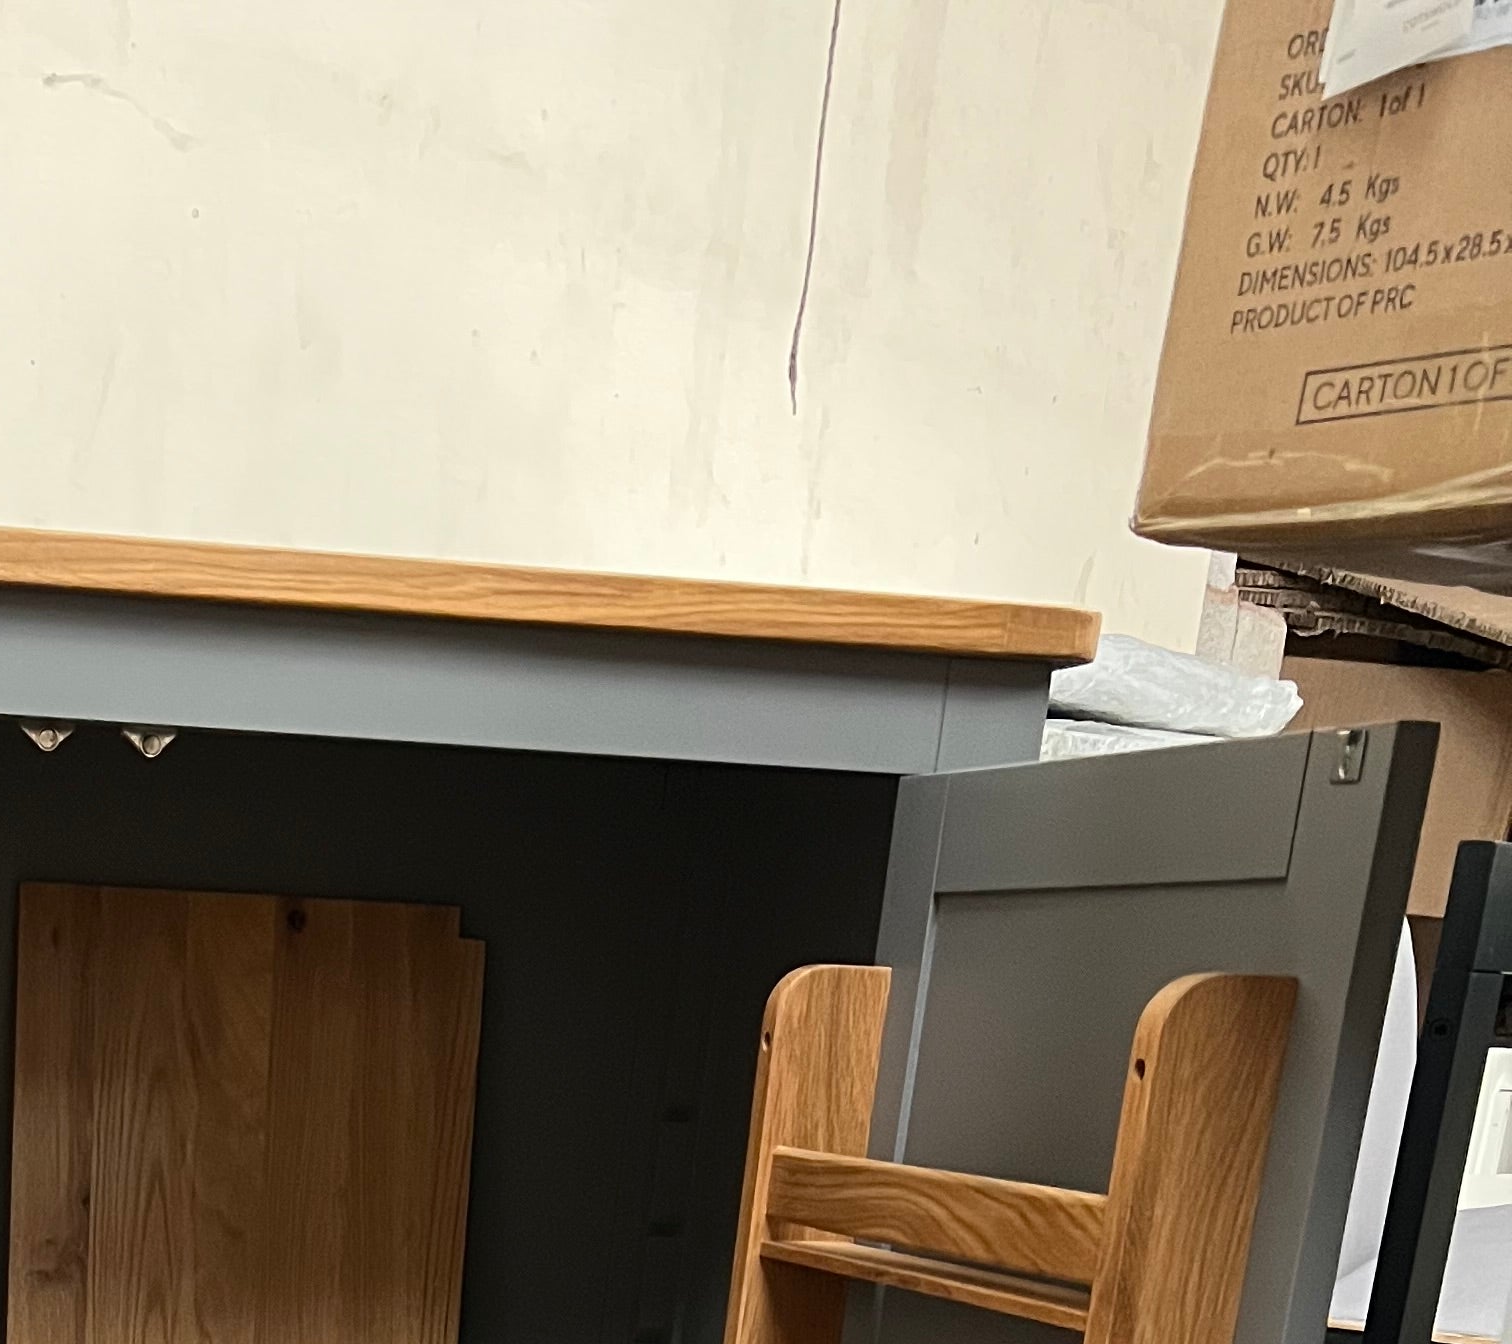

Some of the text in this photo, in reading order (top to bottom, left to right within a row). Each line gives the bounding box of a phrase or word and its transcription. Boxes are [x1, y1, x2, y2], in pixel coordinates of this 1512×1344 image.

[1319, 180, 1351, 208] 4.5
[1364, 172, 1400, 204] Kgs
[1311, 217, 1342, 249] 7.5
[1355, 211, 1391, 244] Kgs
[1237, 251, 1377, 297] DIMENSIONS:
[1313, 365, 1442, 411] CARTON
[1463, 356, 1511, 391] OF
